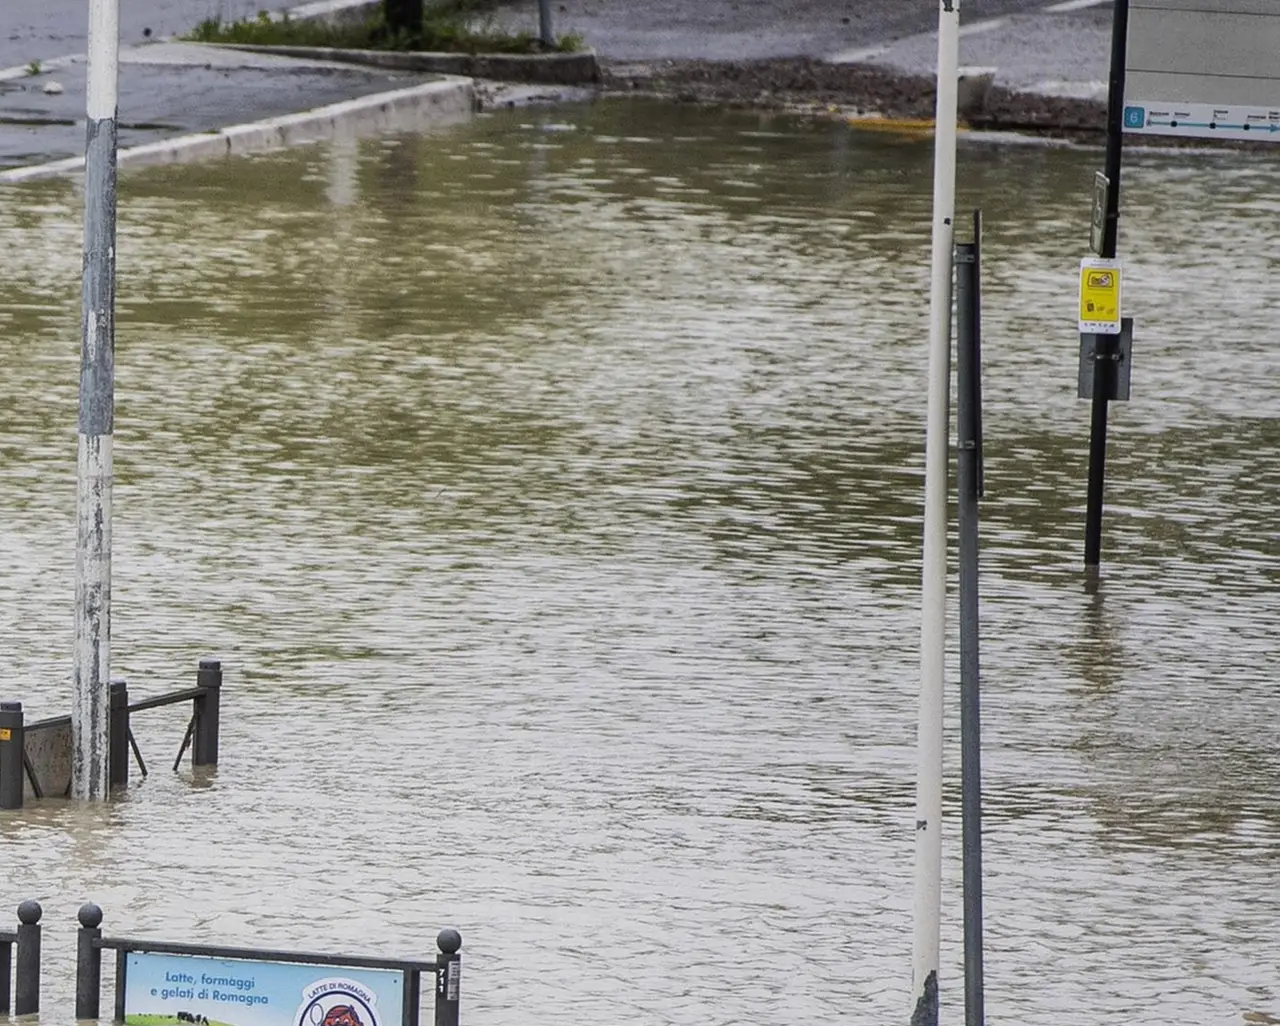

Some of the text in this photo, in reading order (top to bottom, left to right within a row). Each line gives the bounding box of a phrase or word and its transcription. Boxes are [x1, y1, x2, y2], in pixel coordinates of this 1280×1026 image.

[166, 972, 255, 991] Latte, formaggi
[150, 987, 269, 1006] e gelati di Romagna
[308, 984, 328, 999] LATTE
[338, 983, 371, 1004] ROMAGNA
